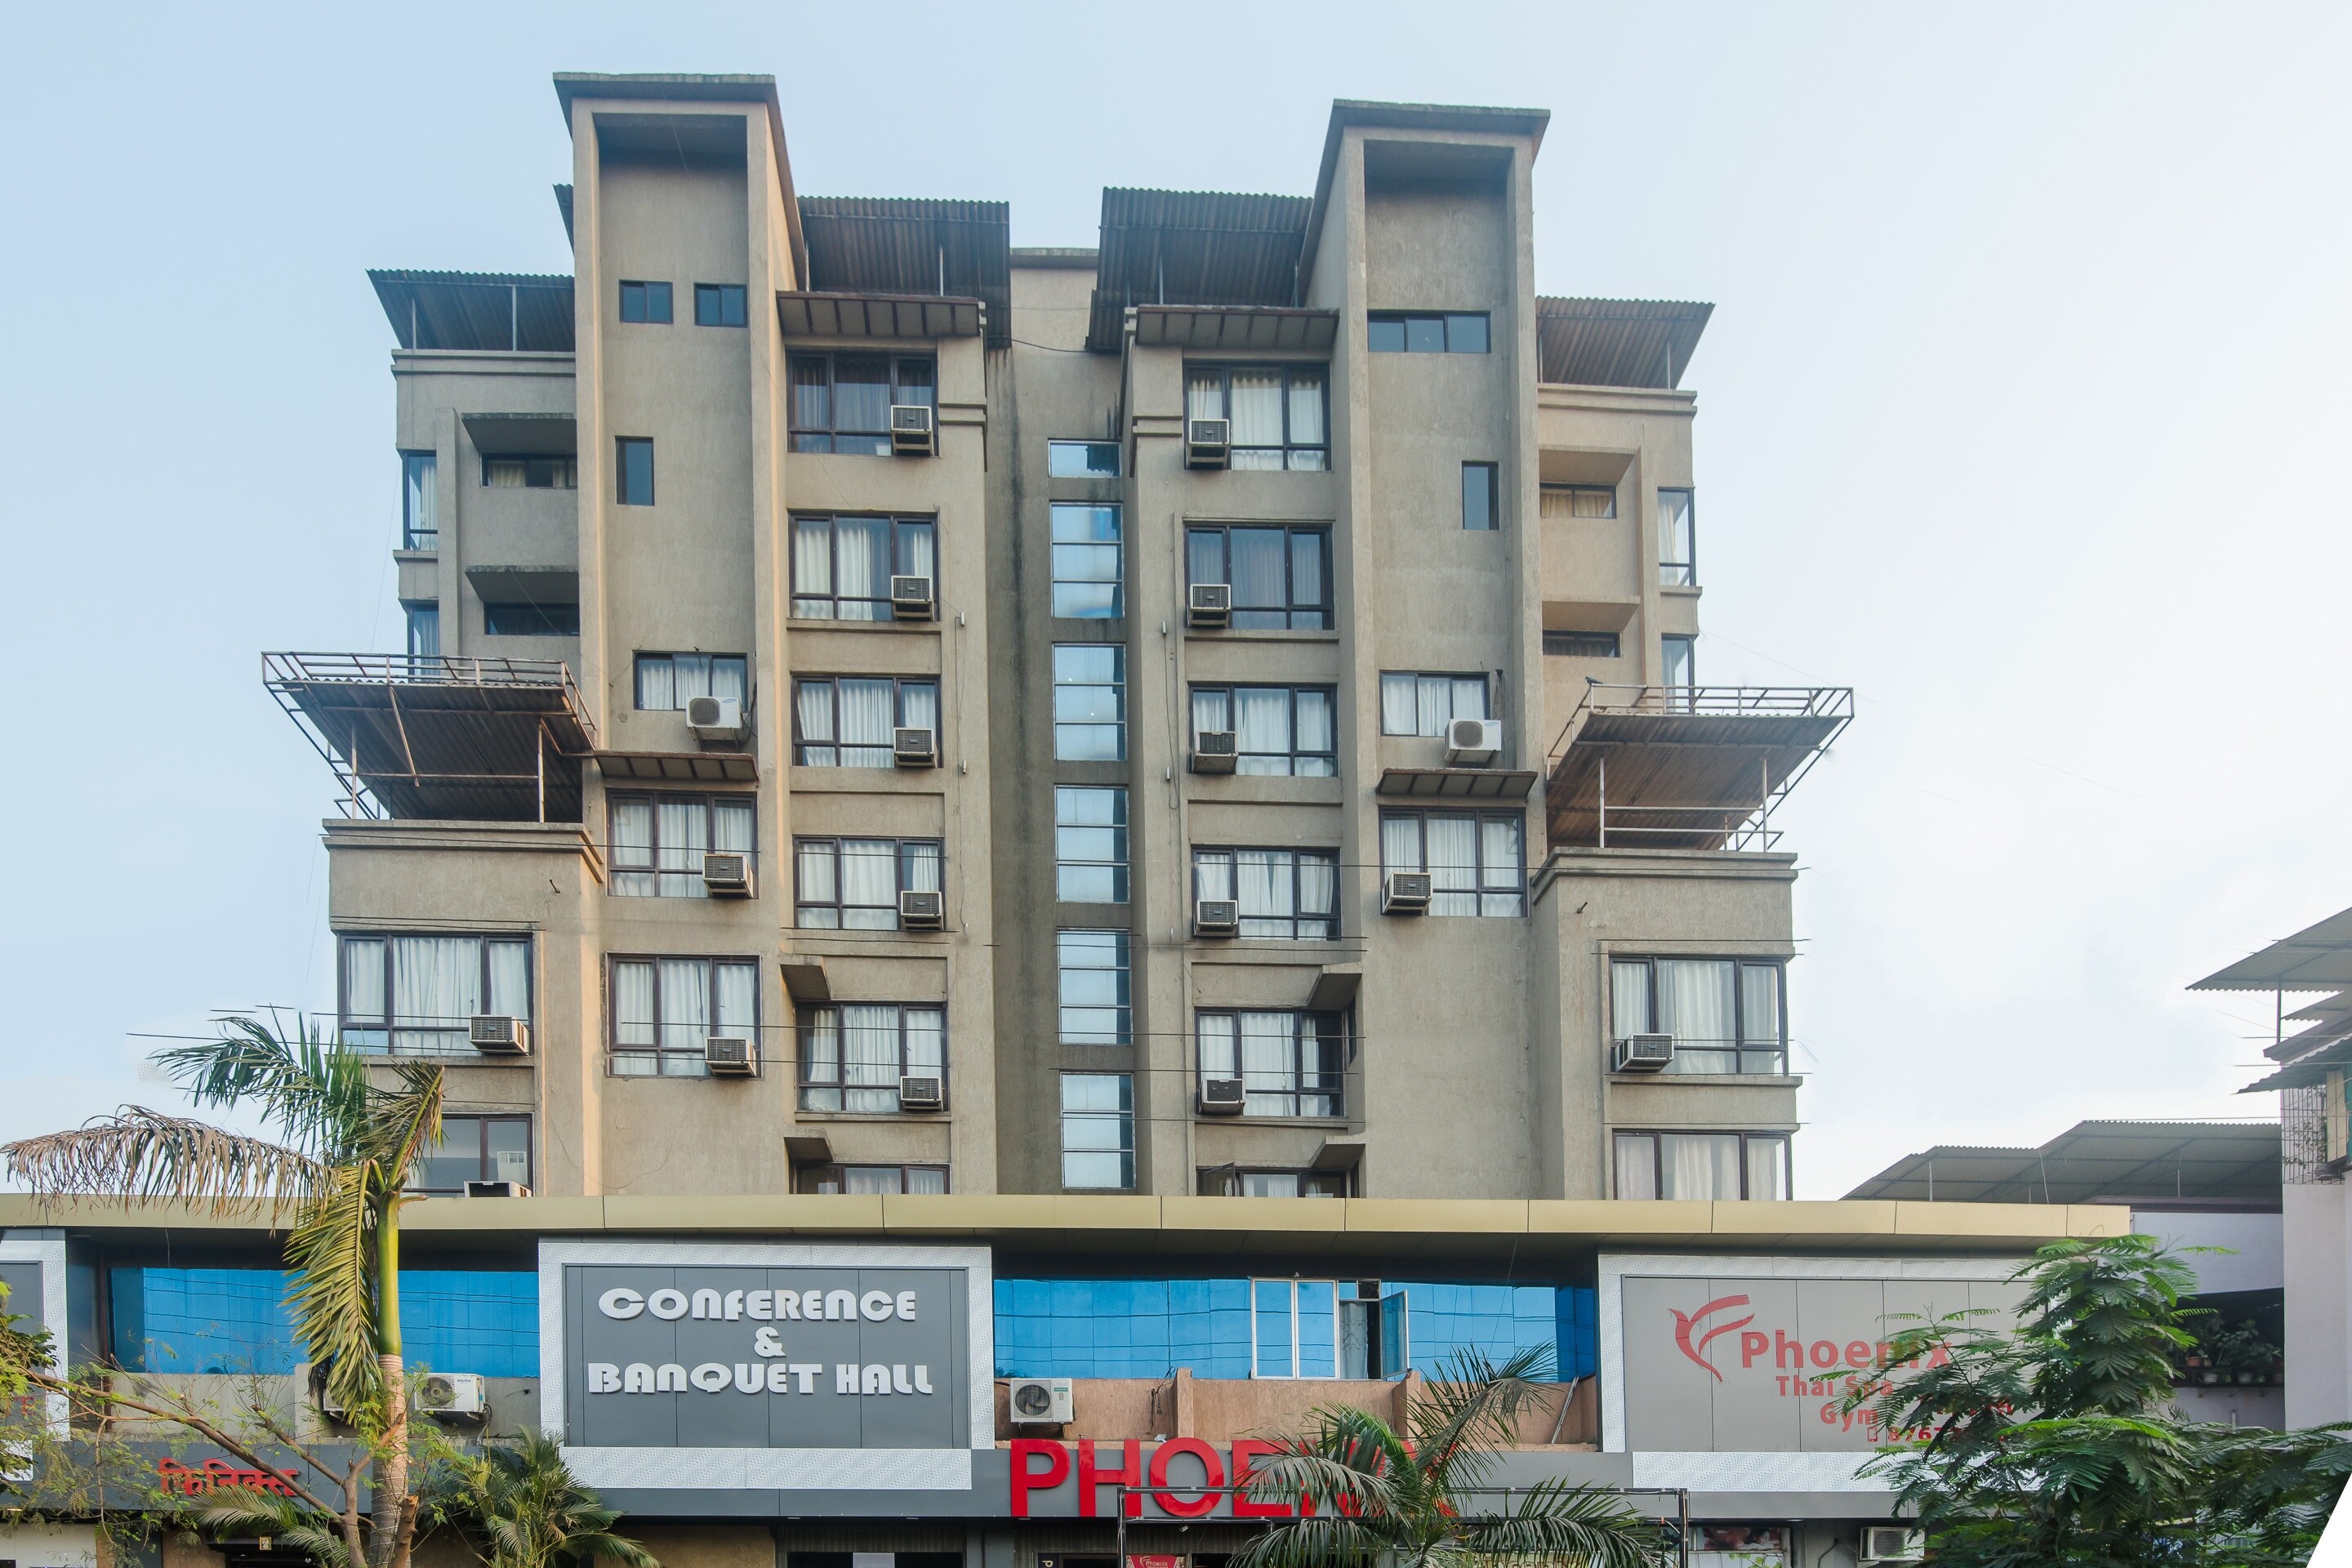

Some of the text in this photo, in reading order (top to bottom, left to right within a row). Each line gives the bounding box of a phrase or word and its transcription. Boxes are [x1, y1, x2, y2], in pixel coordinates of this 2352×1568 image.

[599, 1287, 915, 1322] CONFERENCE
[754, 1326, 786, 1358] &
[587, 1362, 933, 1395] BANQUET HALL
[1775, 1374, 1833, 1396] Thai
[1820, 1403, 1878, 1433] Gym
[1010, 1437, 1460, 1517] PHOE
